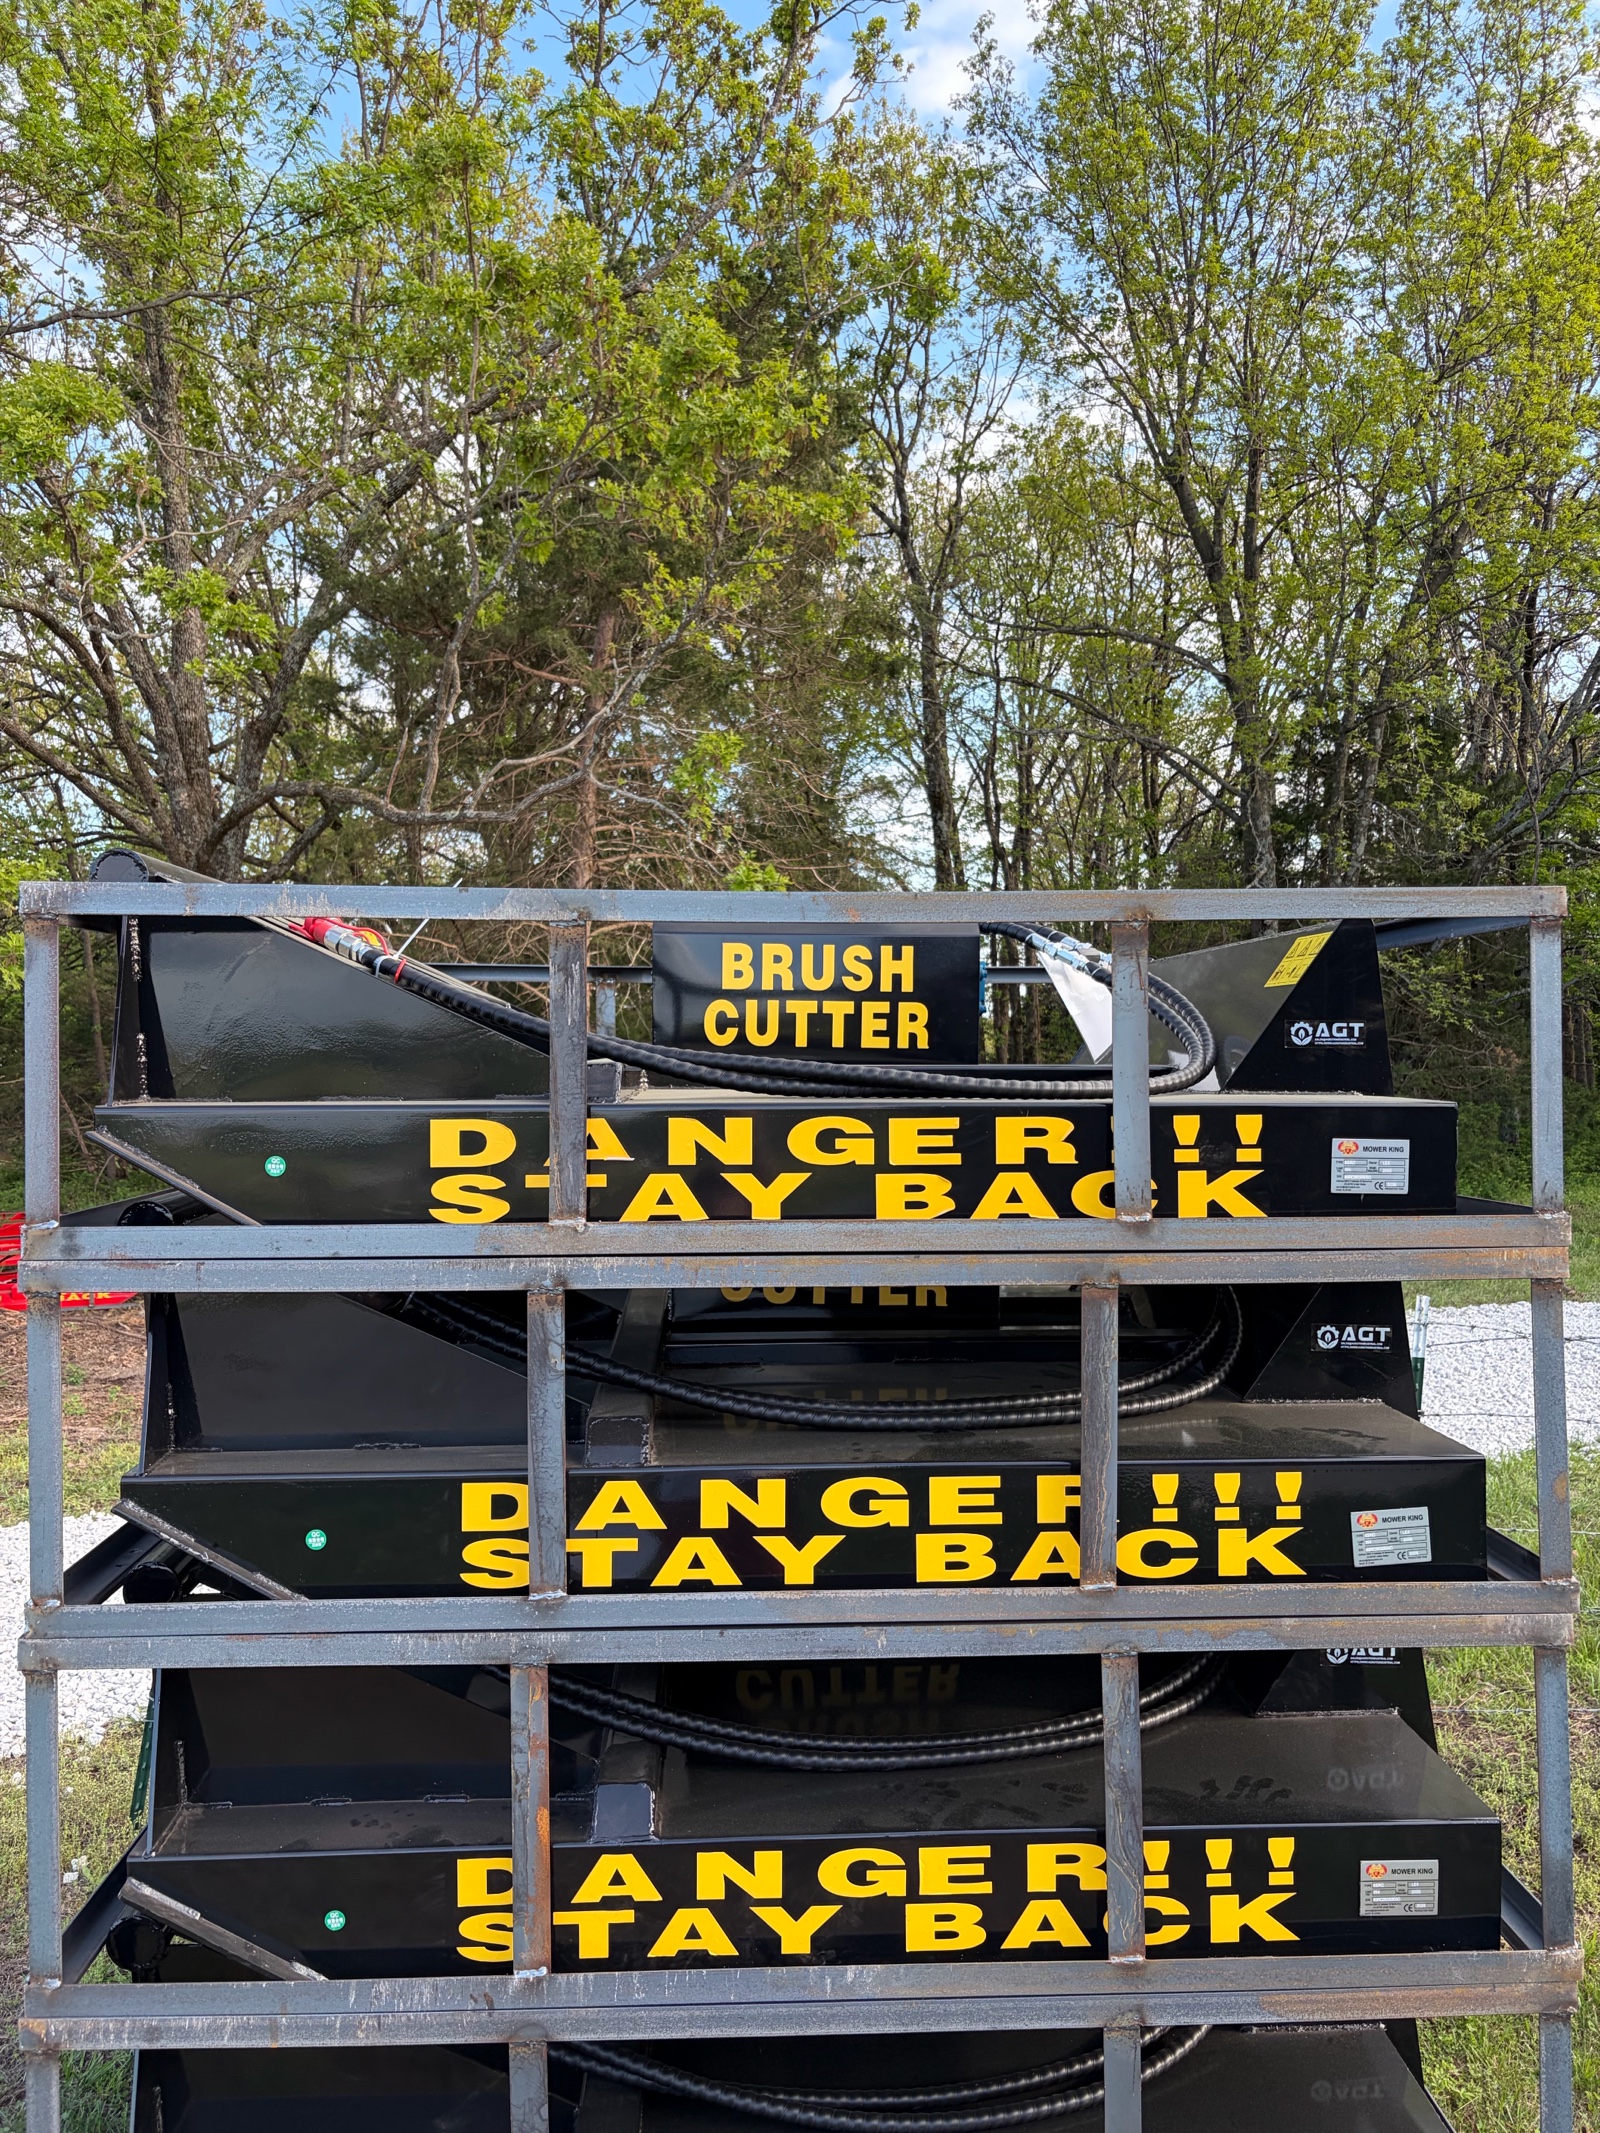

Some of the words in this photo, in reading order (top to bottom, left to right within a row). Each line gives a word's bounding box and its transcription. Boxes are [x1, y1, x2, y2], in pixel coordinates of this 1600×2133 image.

[722, 942, 914, 992] BRUSH
[704, 999, 930, 1049] CUTTER
[1315, 1022, 1364, 1038] AGT
[430, 1114, 1263, 1168] DANGER!!
[876, 1170, 1268, 1220] BACK
[1341, 1326, 1391, 1342] AGT
[1382, 1515, 1407, 1523] MOWER
[1407, 1514, 1424, 1522] KING
[460, 1535, 846, 1589] STAY
[916, 1527, 1307, 1583] BACK
[456, 1836, 1295, 1907] DANGER!!!
[456, 1905, 844, 1962] STAY
